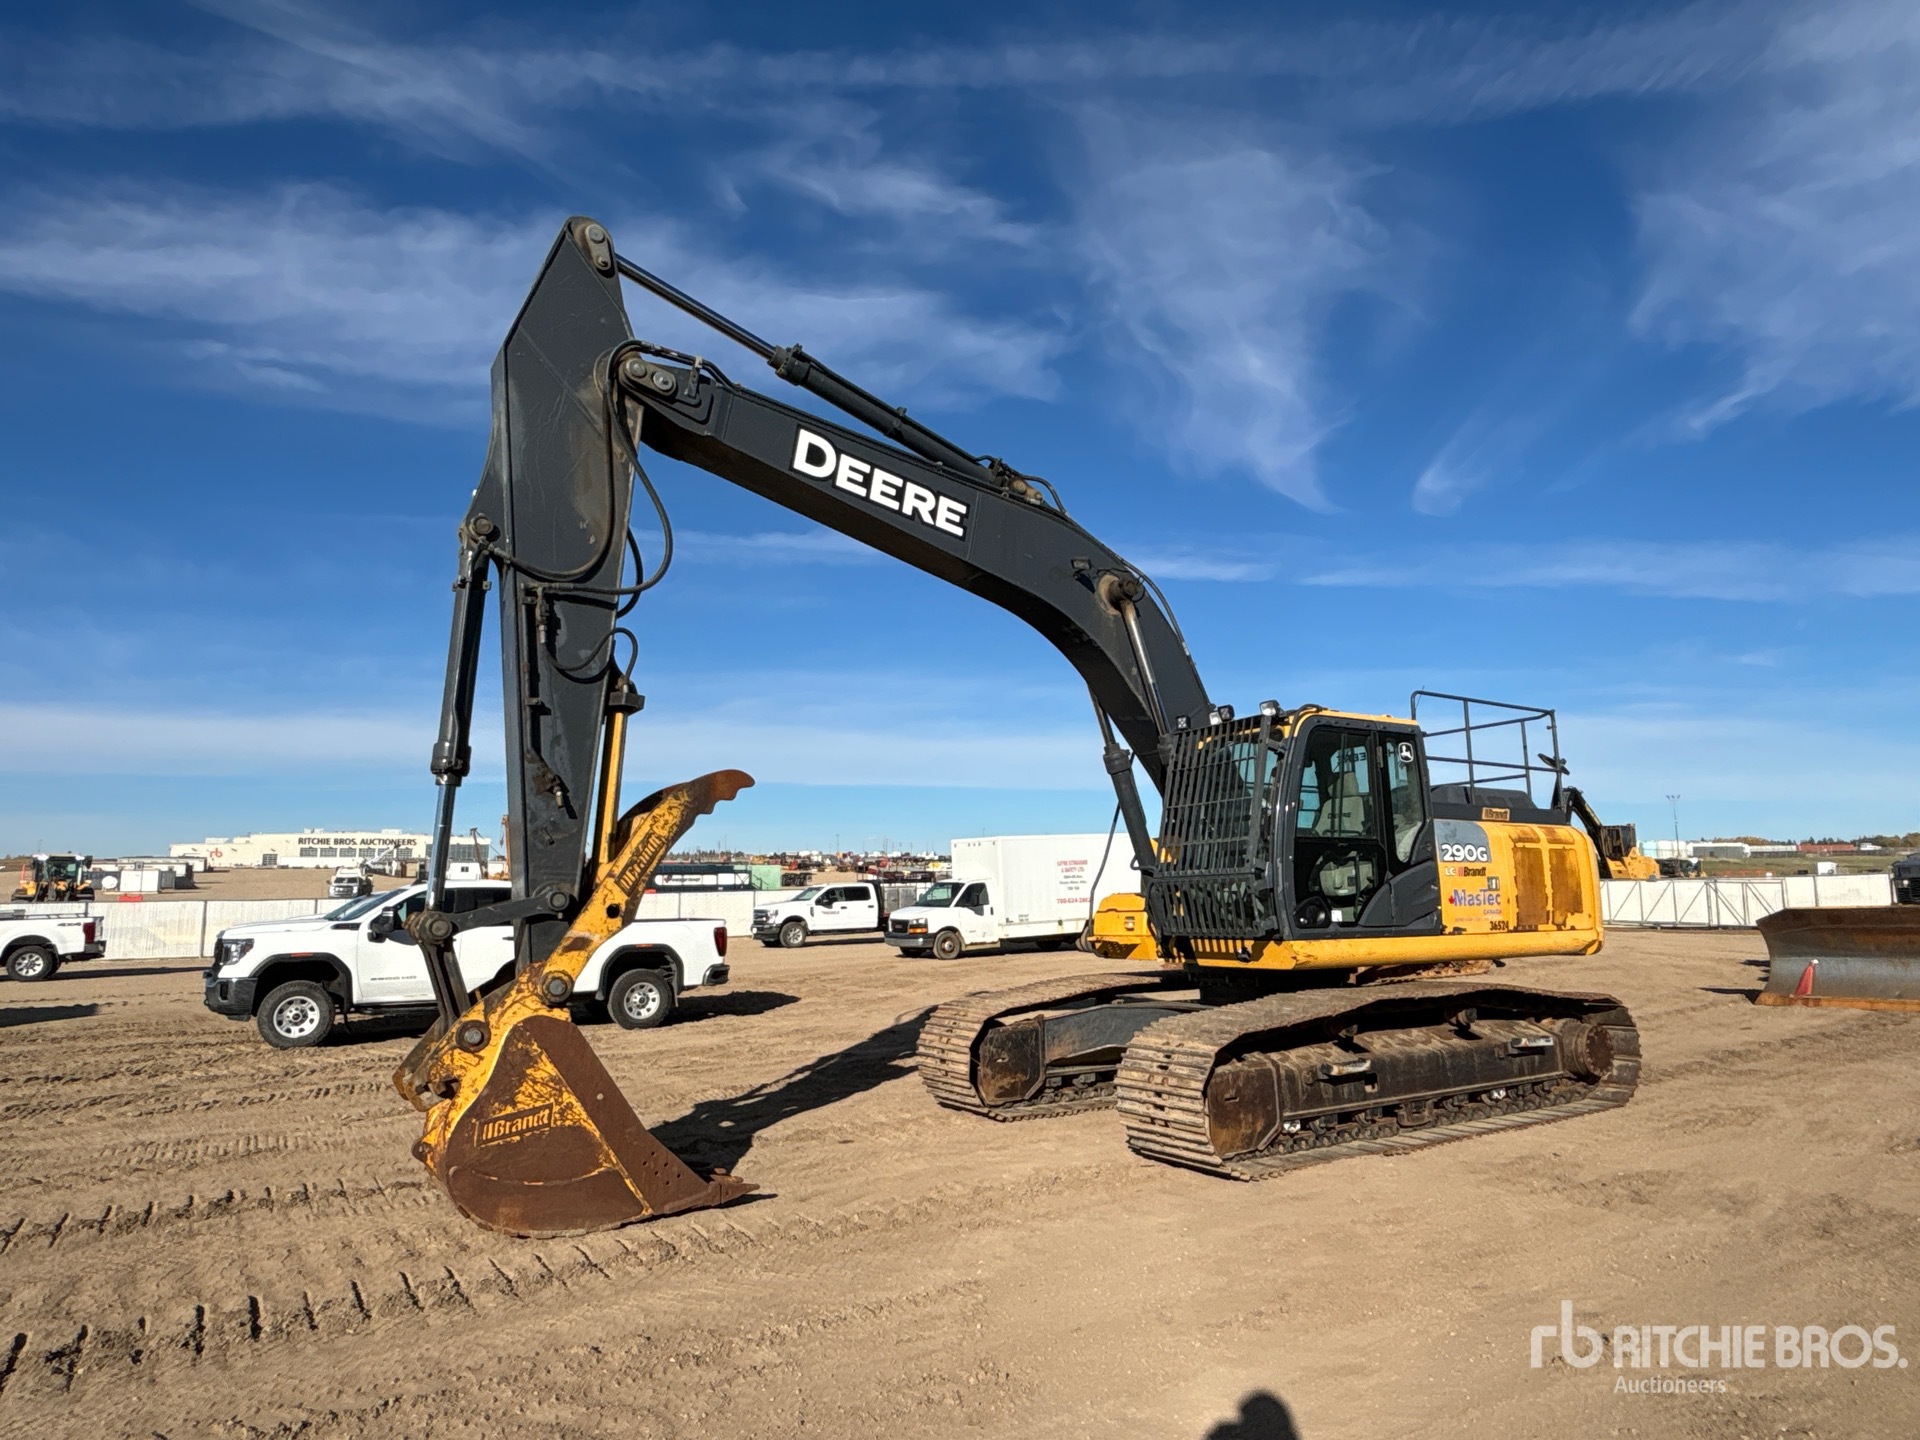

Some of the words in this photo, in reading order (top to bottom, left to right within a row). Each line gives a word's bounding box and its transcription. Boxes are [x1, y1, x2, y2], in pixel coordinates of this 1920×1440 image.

[792, 428, 967, 537] DEERE
[298, 837, 331, 846] RITCHIE
[333, 837, 358, 846] BROS.
[360, 838, 417, 846] AUCTIONEERS
[209, 848, 223, 858] rb
[1441, 844, 1488, 862] 290G
[1445, 867, 1456, 876] LC
[1463, 867, 1487, 877] Brandt
[1453, 889, 1502, 907] MasTec
